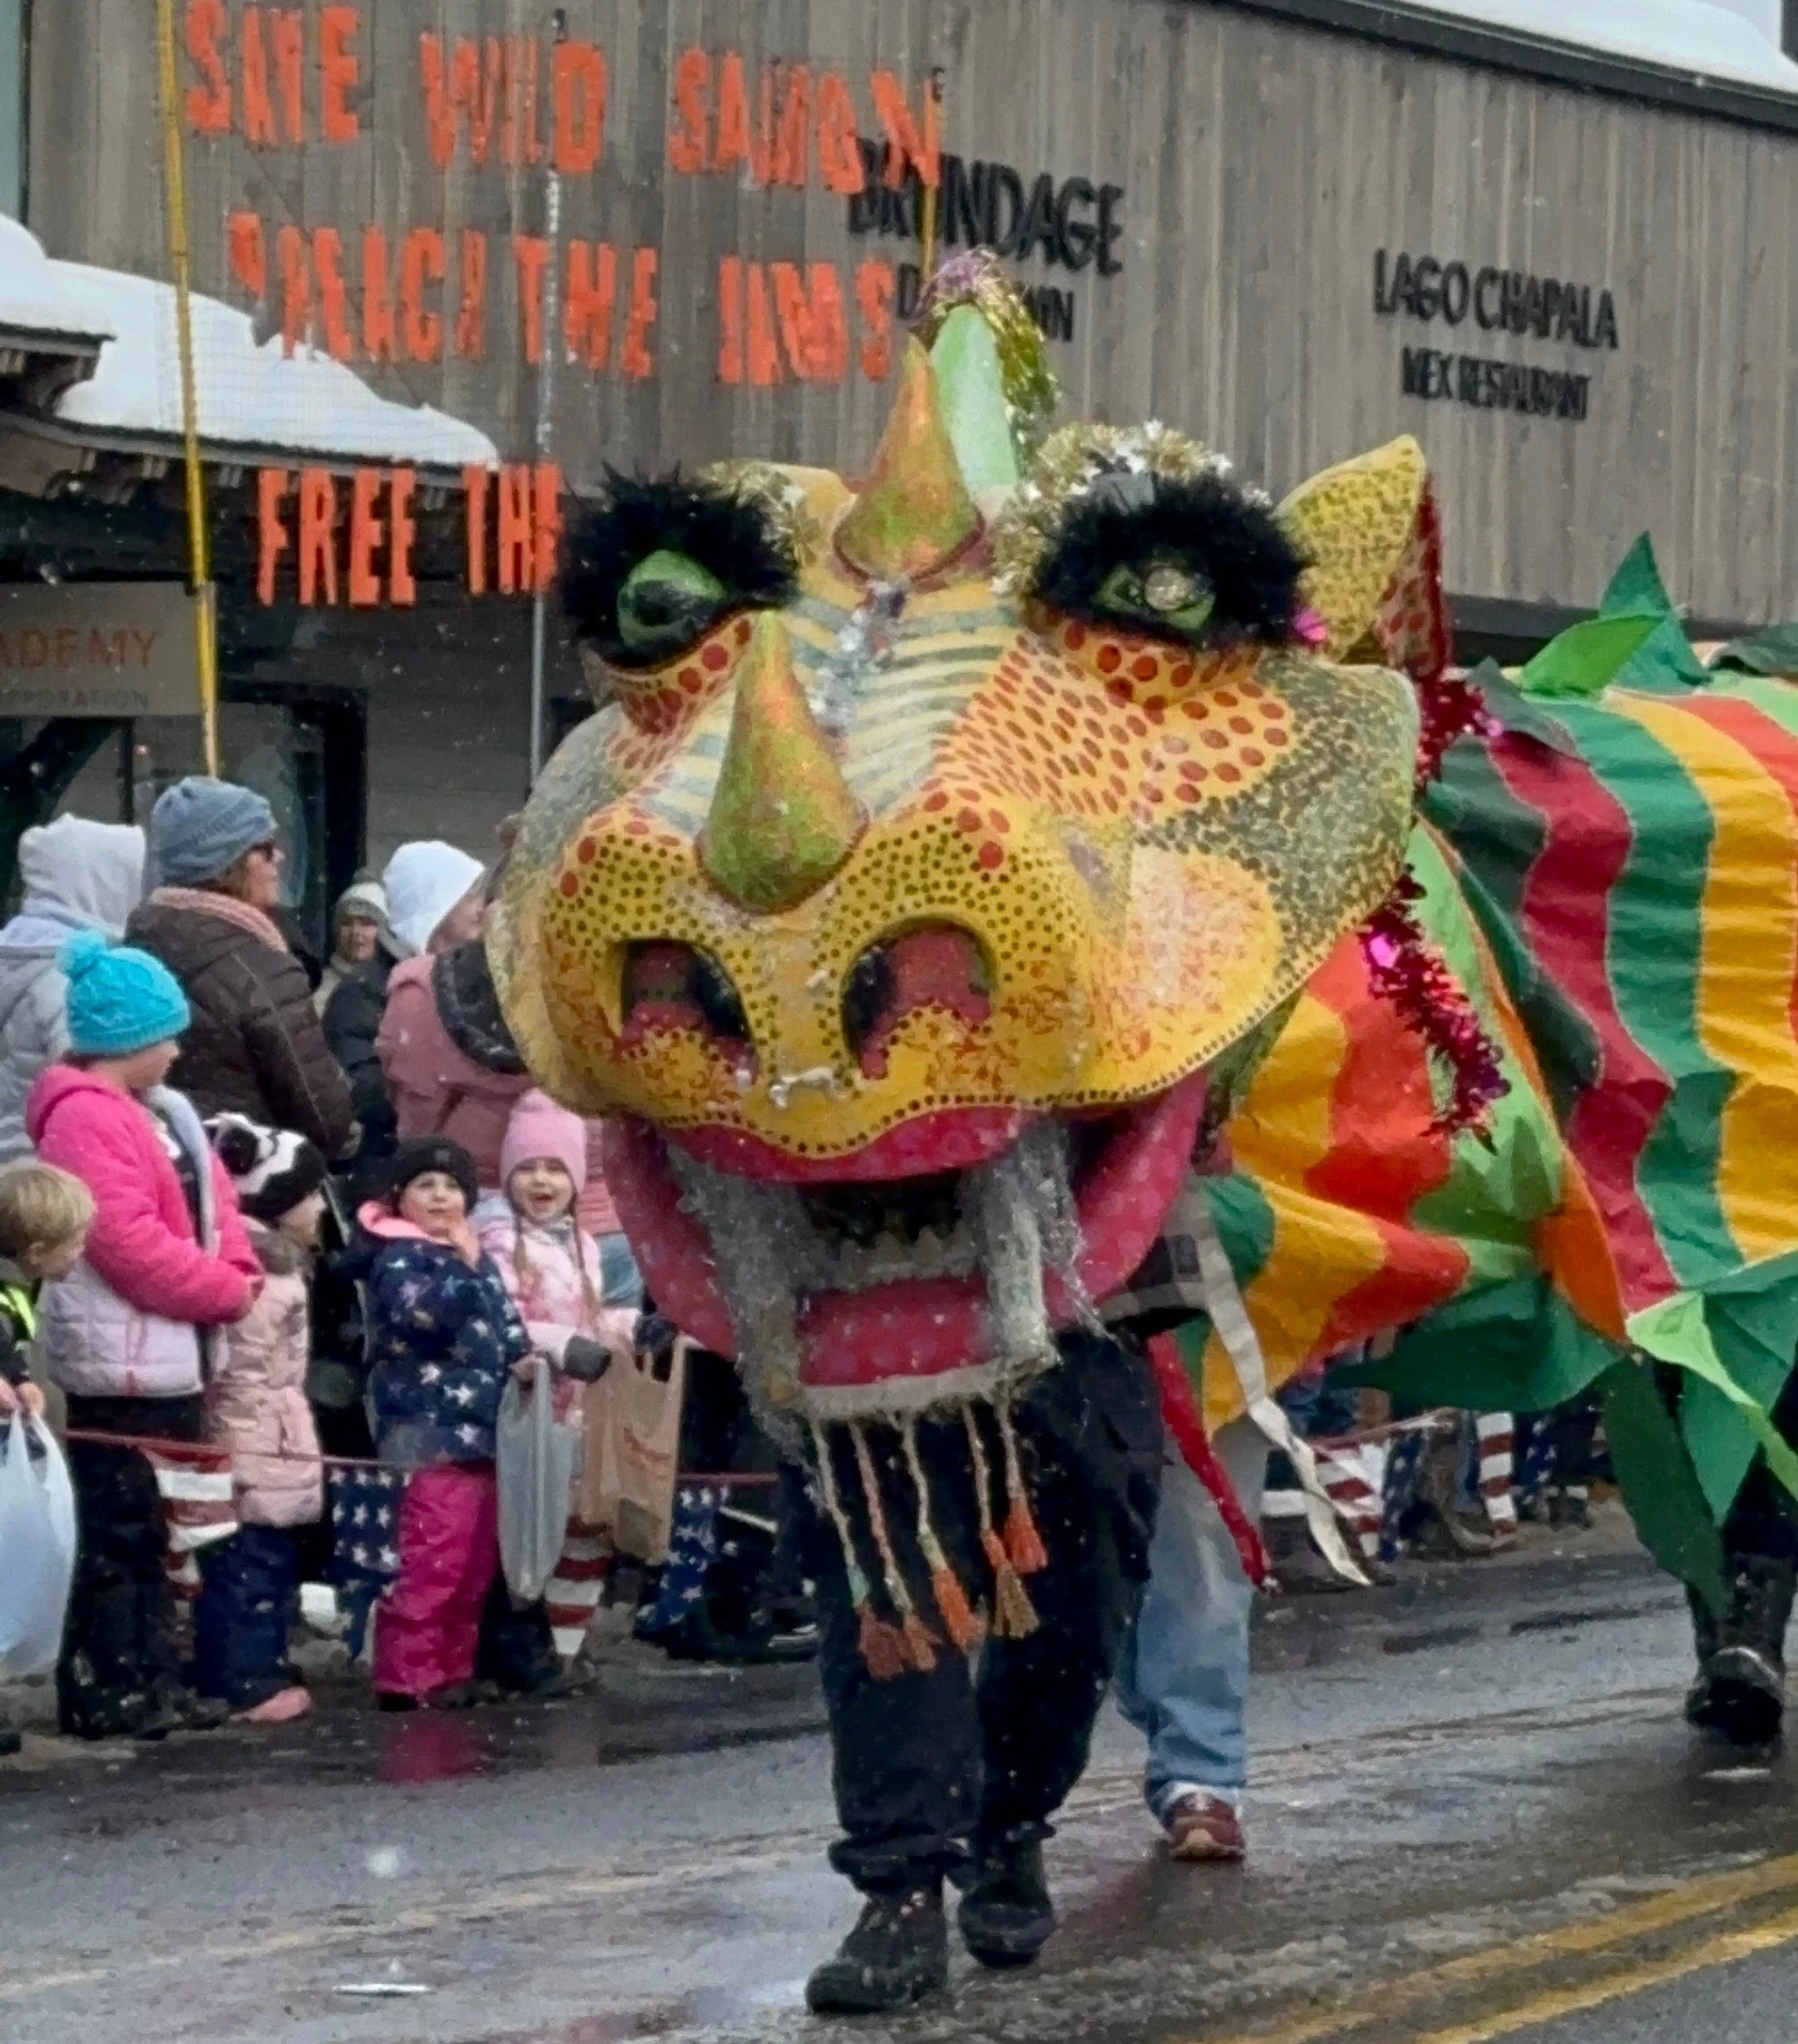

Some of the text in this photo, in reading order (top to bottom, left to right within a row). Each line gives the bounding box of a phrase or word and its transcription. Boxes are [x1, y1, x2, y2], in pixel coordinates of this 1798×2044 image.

[514, 233, 657, 379] THE
[1373, 249, 1618, 350] LAGO CHAPALA
[257, 467, 417, 607] FREE
